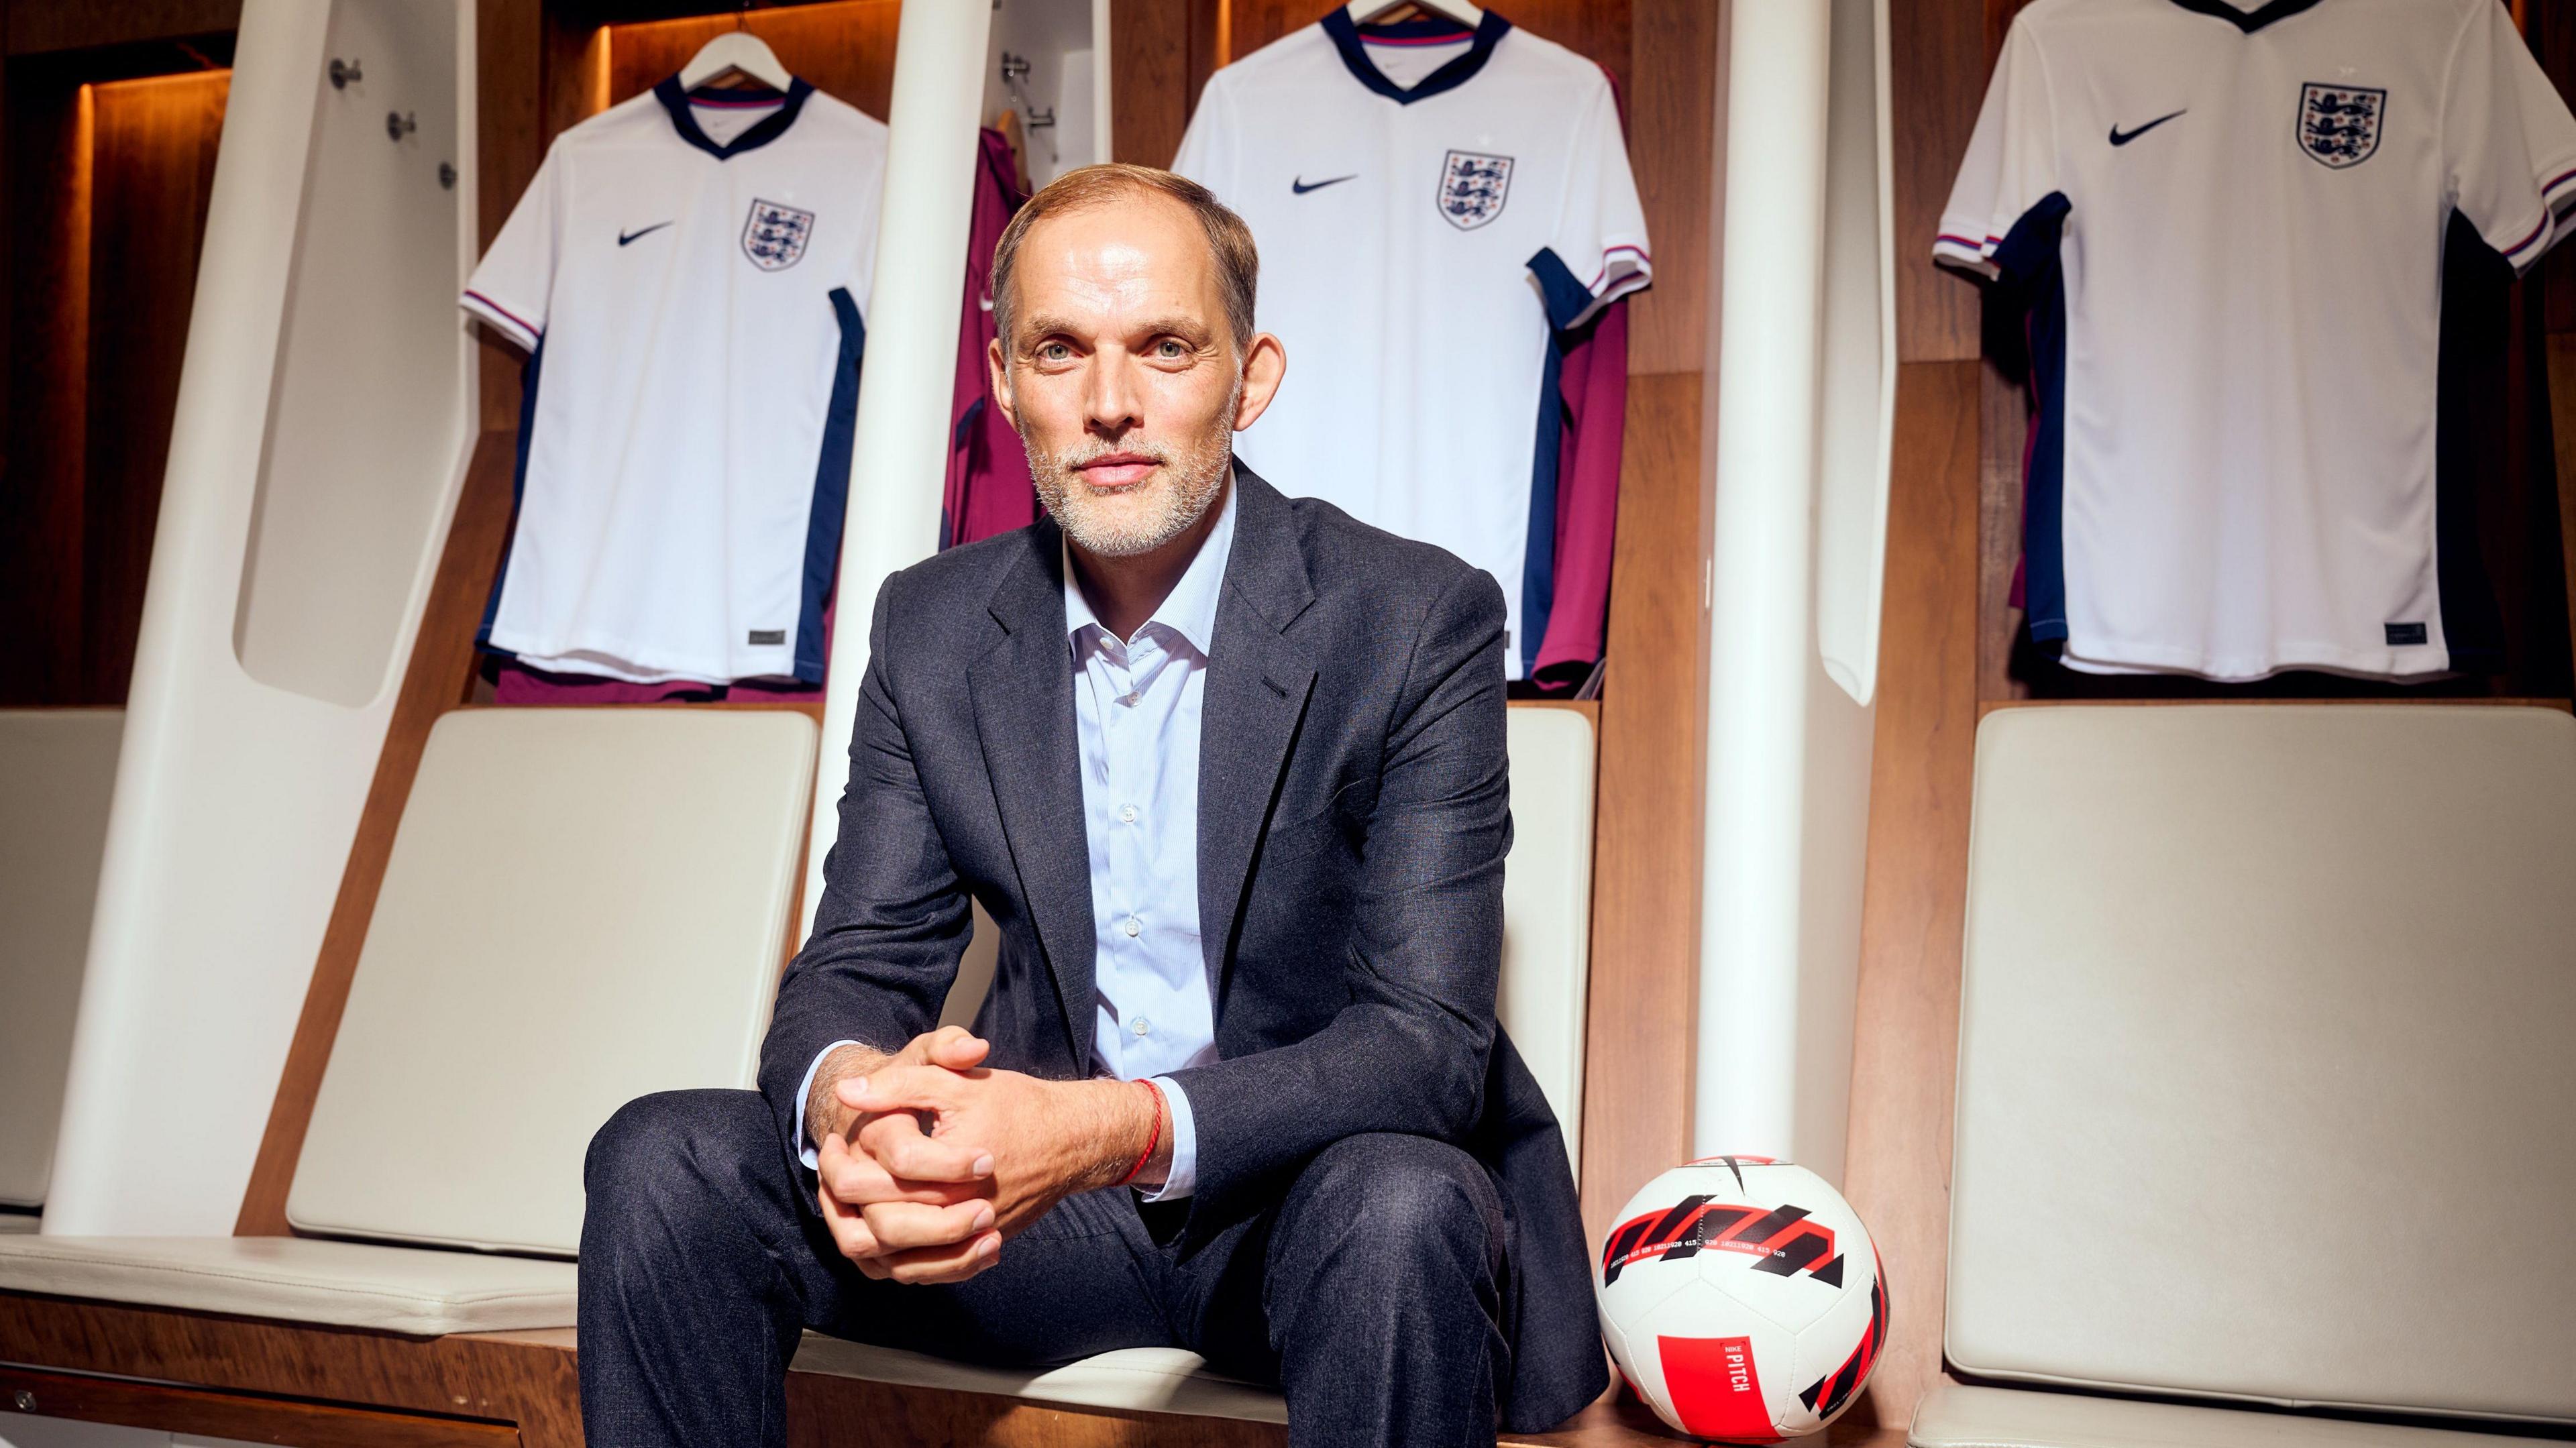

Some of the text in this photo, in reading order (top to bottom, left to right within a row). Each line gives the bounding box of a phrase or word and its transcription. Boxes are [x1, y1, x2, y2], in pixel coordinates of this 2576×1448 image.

[1758, 1245, 1770, 1254] 415
[1773, 1249, 1786, 1258] 920
[1726, 1354, 1751, 1392] PITCH
